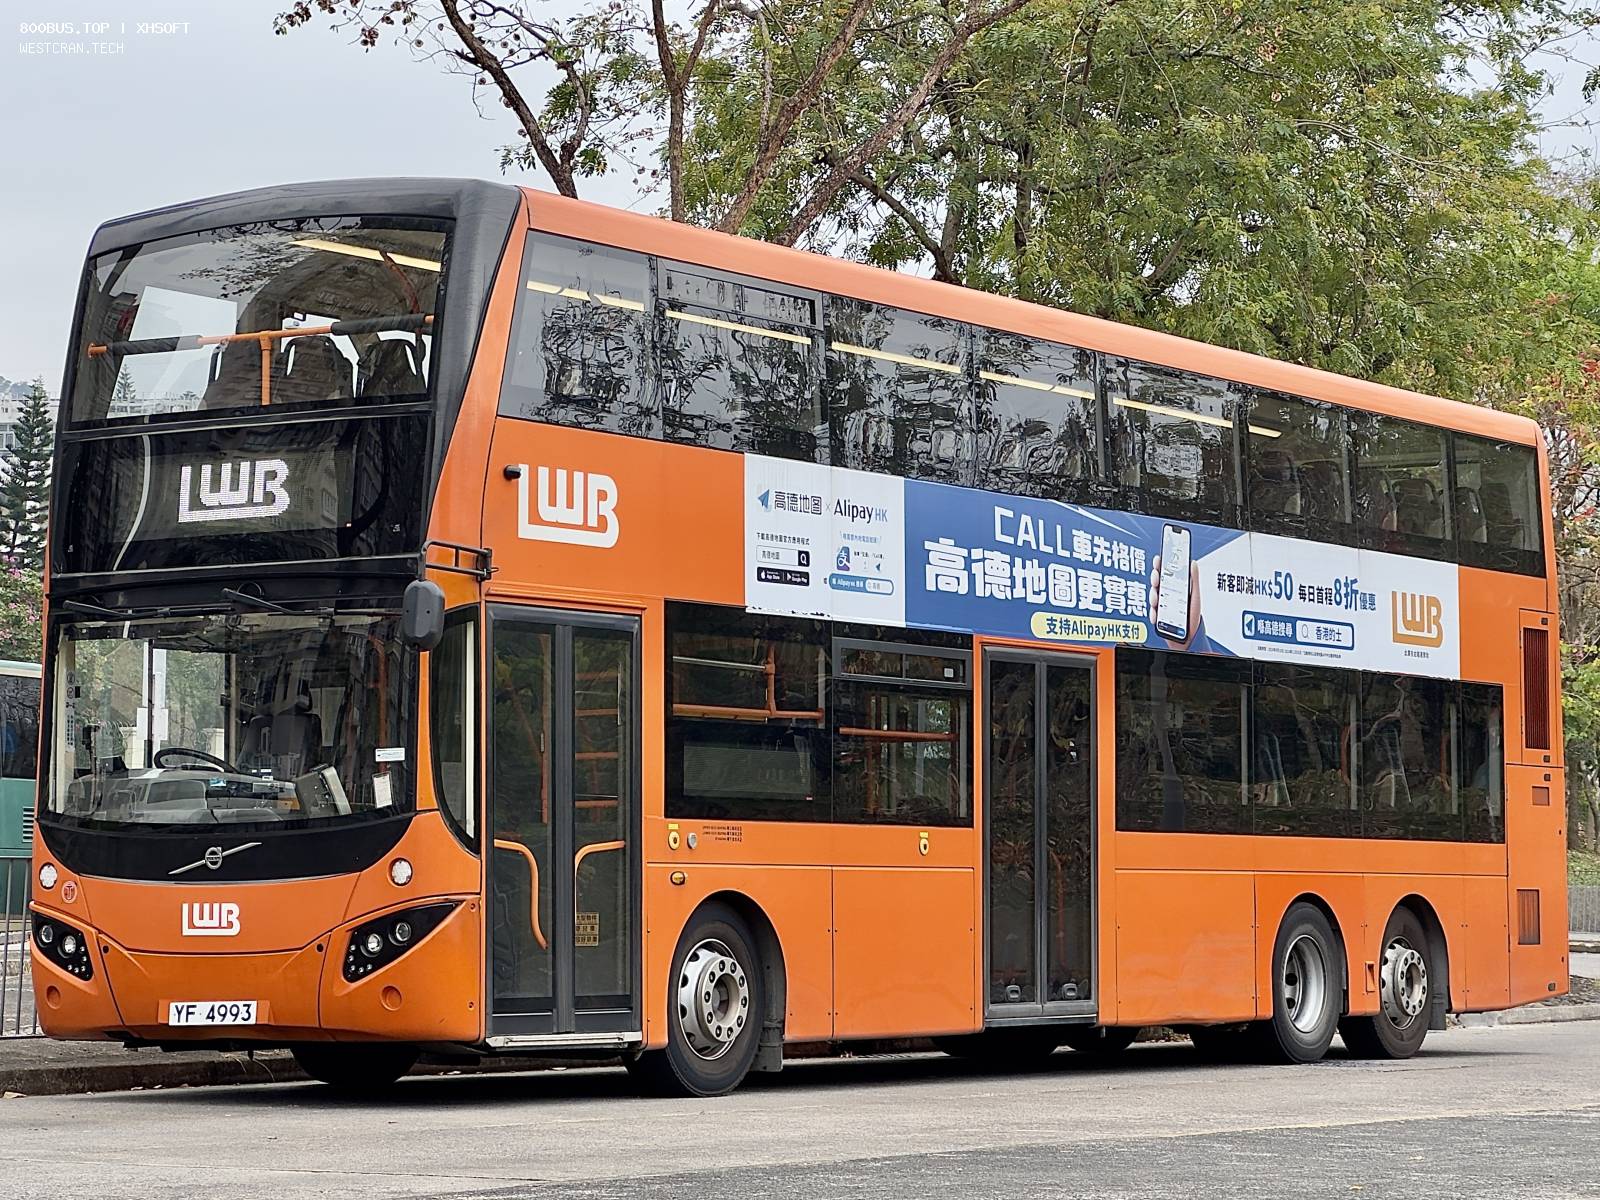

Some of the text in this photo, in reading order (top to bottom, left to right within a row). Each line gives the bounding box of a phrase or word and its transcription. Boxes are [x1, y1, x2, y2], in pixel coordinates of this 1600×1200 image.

[178, 458, 290, 523] LWB
[518, 463, 620, 549] LWB
[924, 538, 1148, 617] 高德地圖更實惠
[1045, 616, 1140, 640] 支持AlipayHK支付
[1315, 626, 1342, 642] 香港的士
[1391, 590, 1443, 648] LWB
[181, 902, 240, 937] LWB
[174, 1003, 252, 1023] YF 4993
